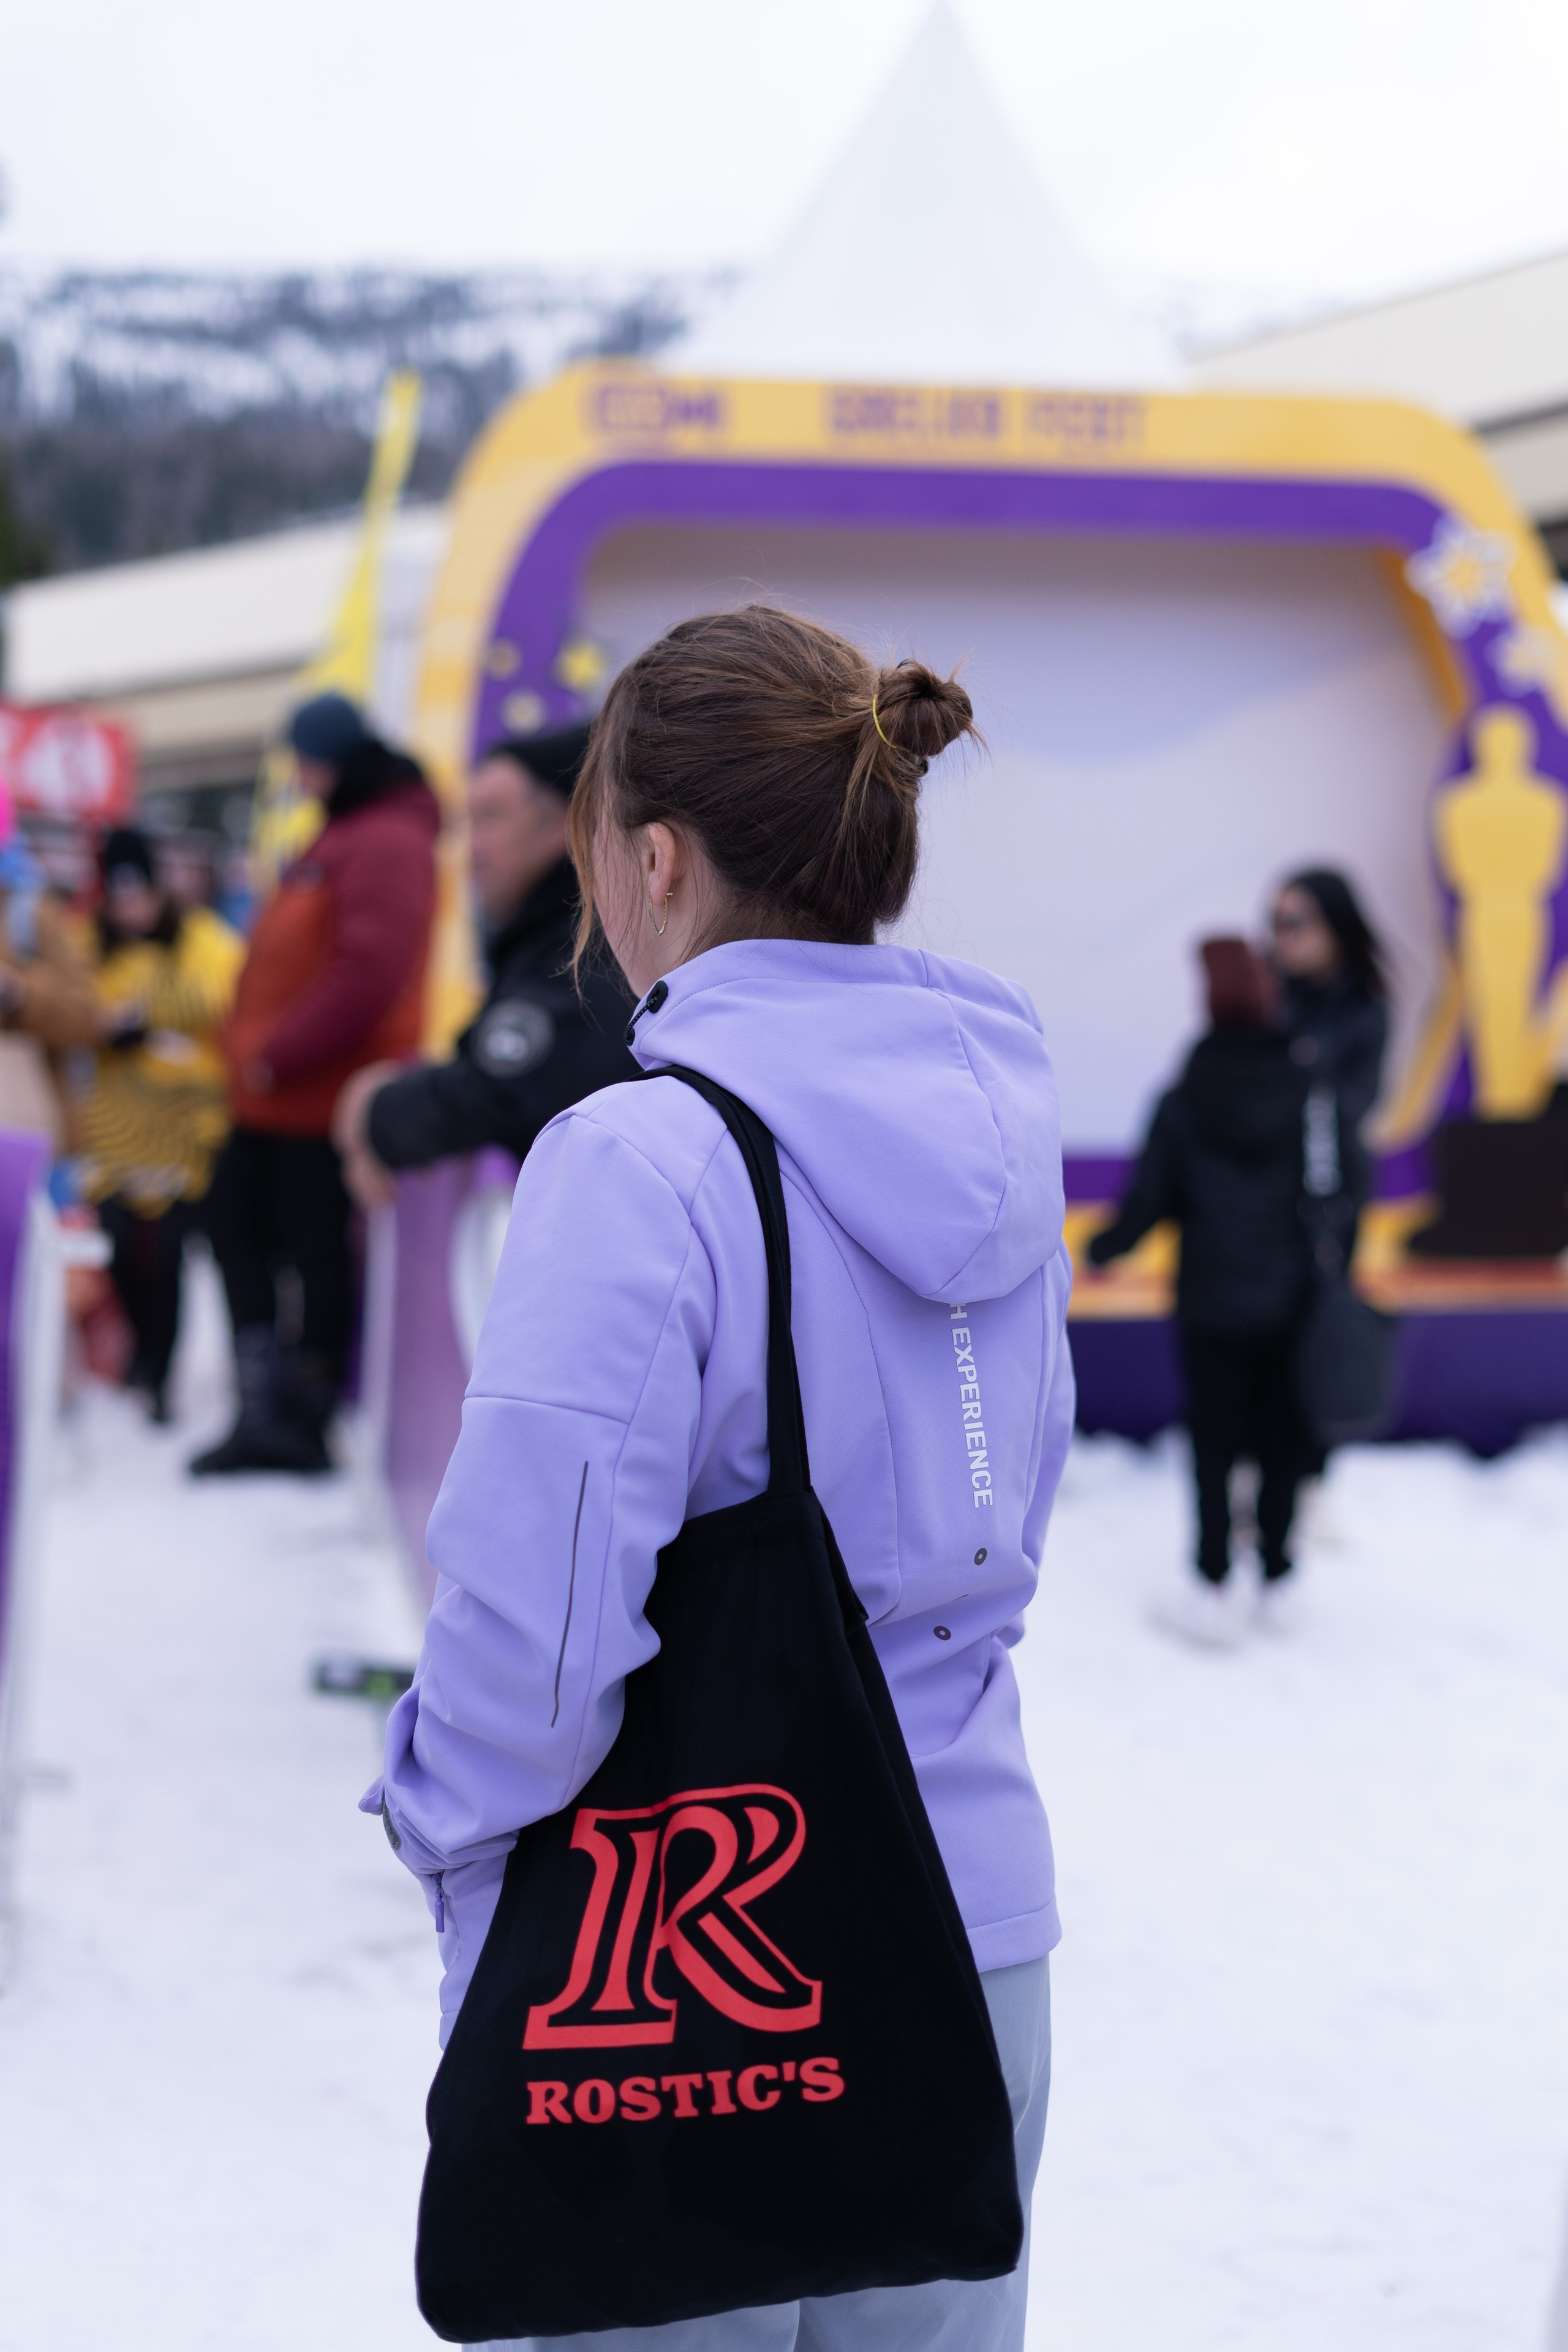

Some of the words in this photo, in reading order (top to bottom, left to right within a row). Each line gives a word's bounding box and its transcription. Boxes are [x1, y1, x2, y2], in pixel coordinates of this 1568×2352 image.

[952, 1327, 993, 1508] EXPERIENCE
[522, 1783, 822, 2050] R
[526, 2057, 845, 2124] ROSTIC'S
